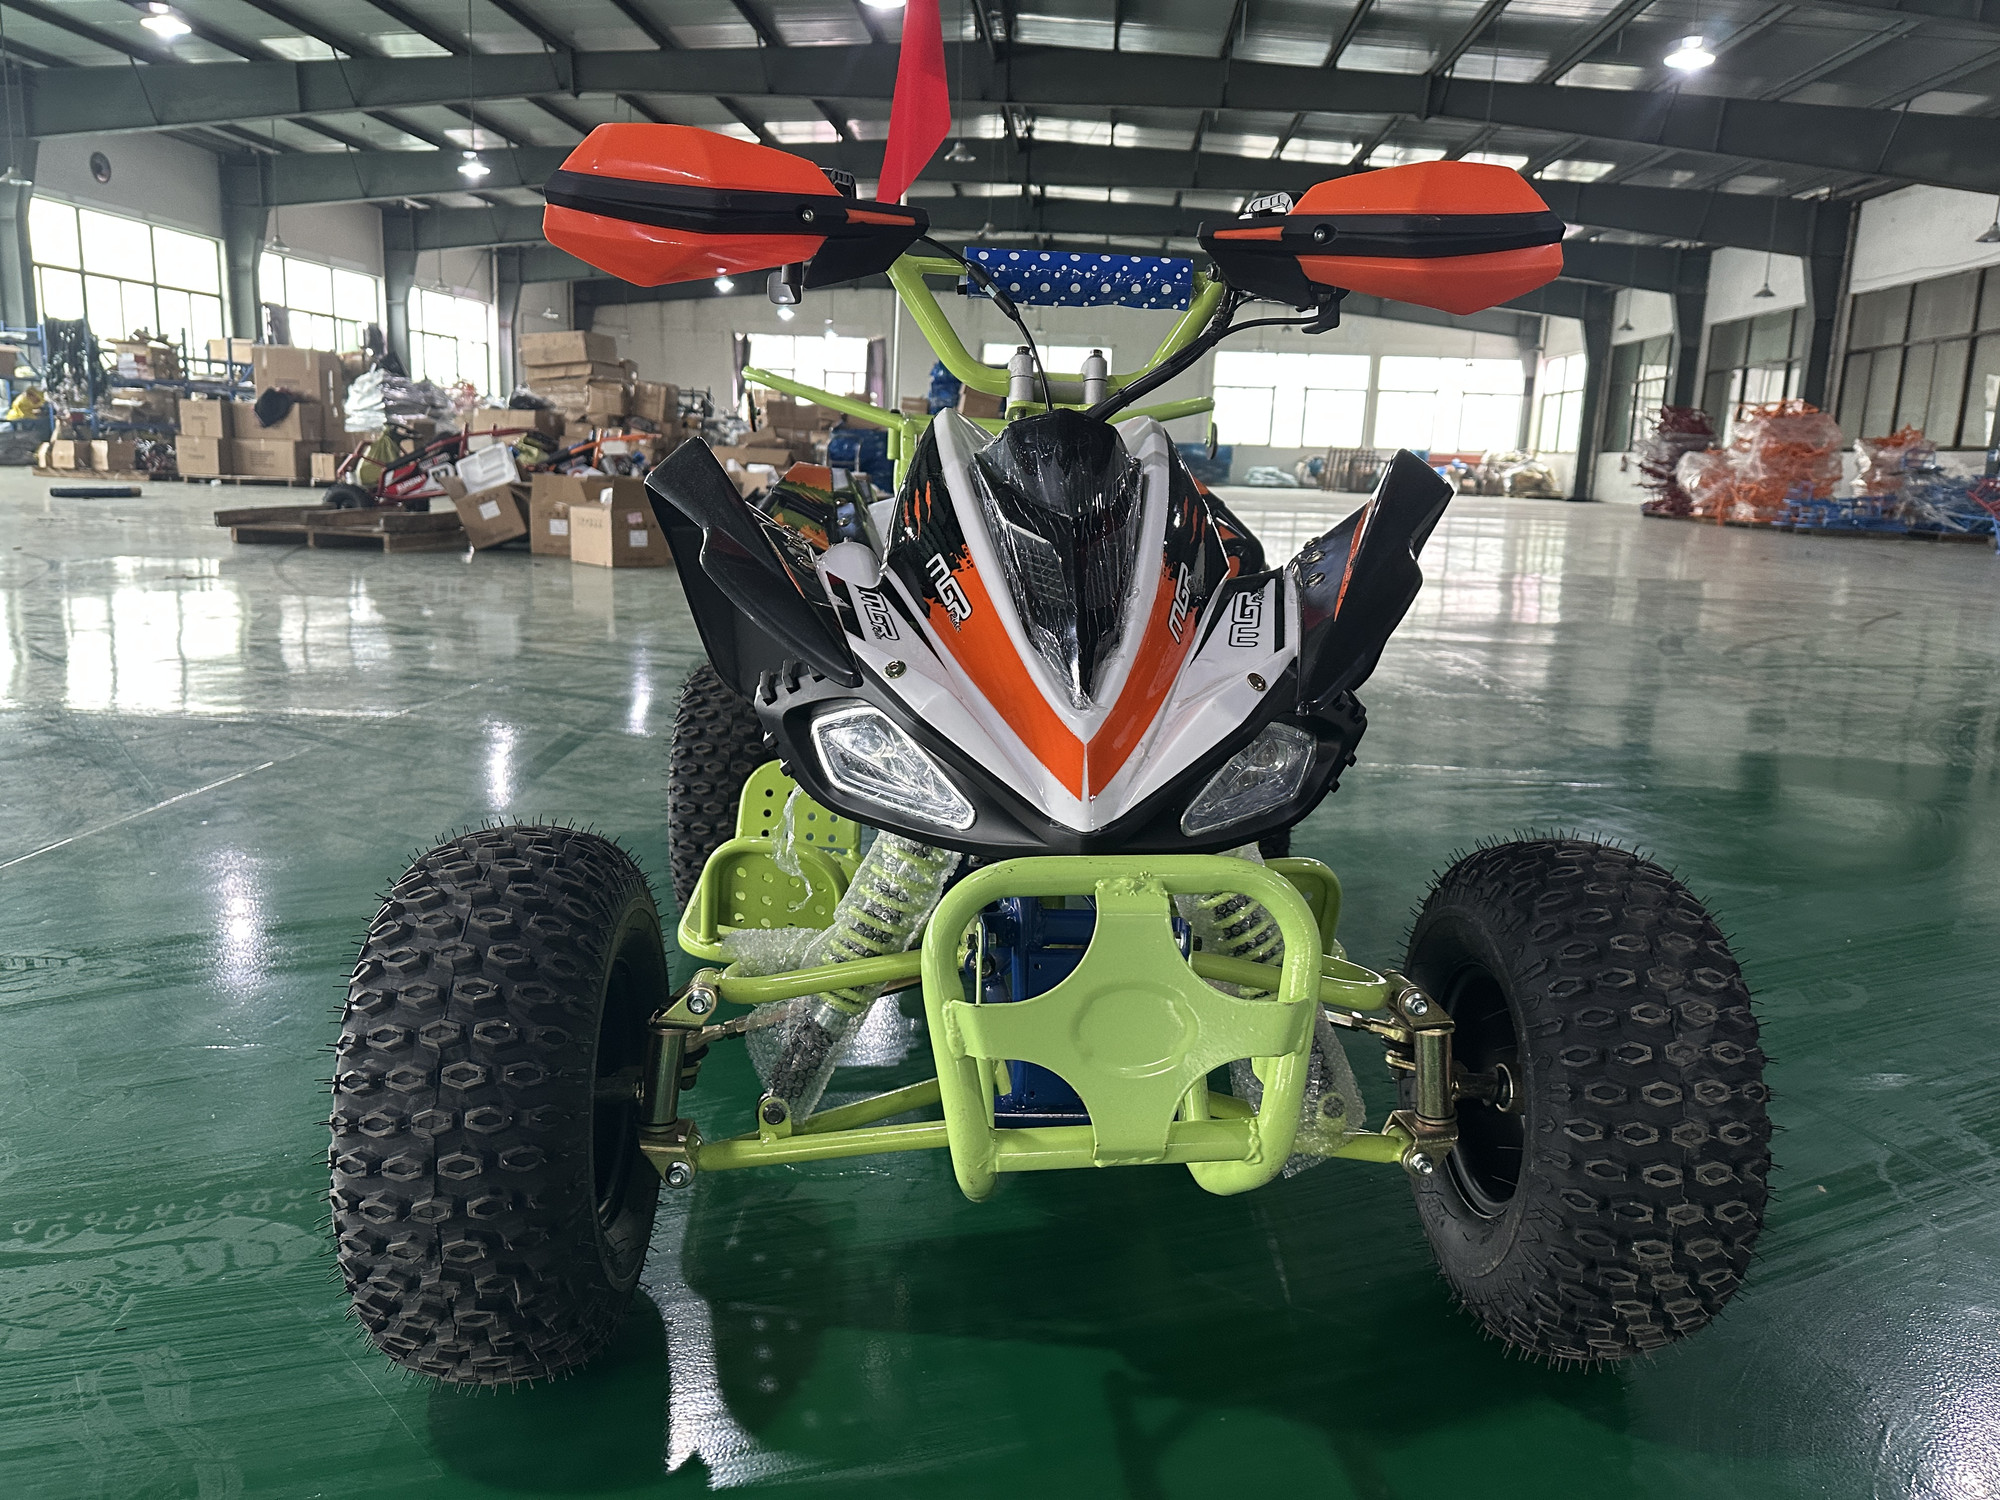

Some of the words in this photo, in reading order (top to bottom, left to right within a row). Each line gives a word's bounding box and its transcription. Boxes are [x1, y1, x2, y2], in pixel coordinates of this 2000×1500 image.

[925, 552, 972, 620] MGR
[859, 590, 900, 640] MGR
[1229, 591, 1263, 647] MGR
